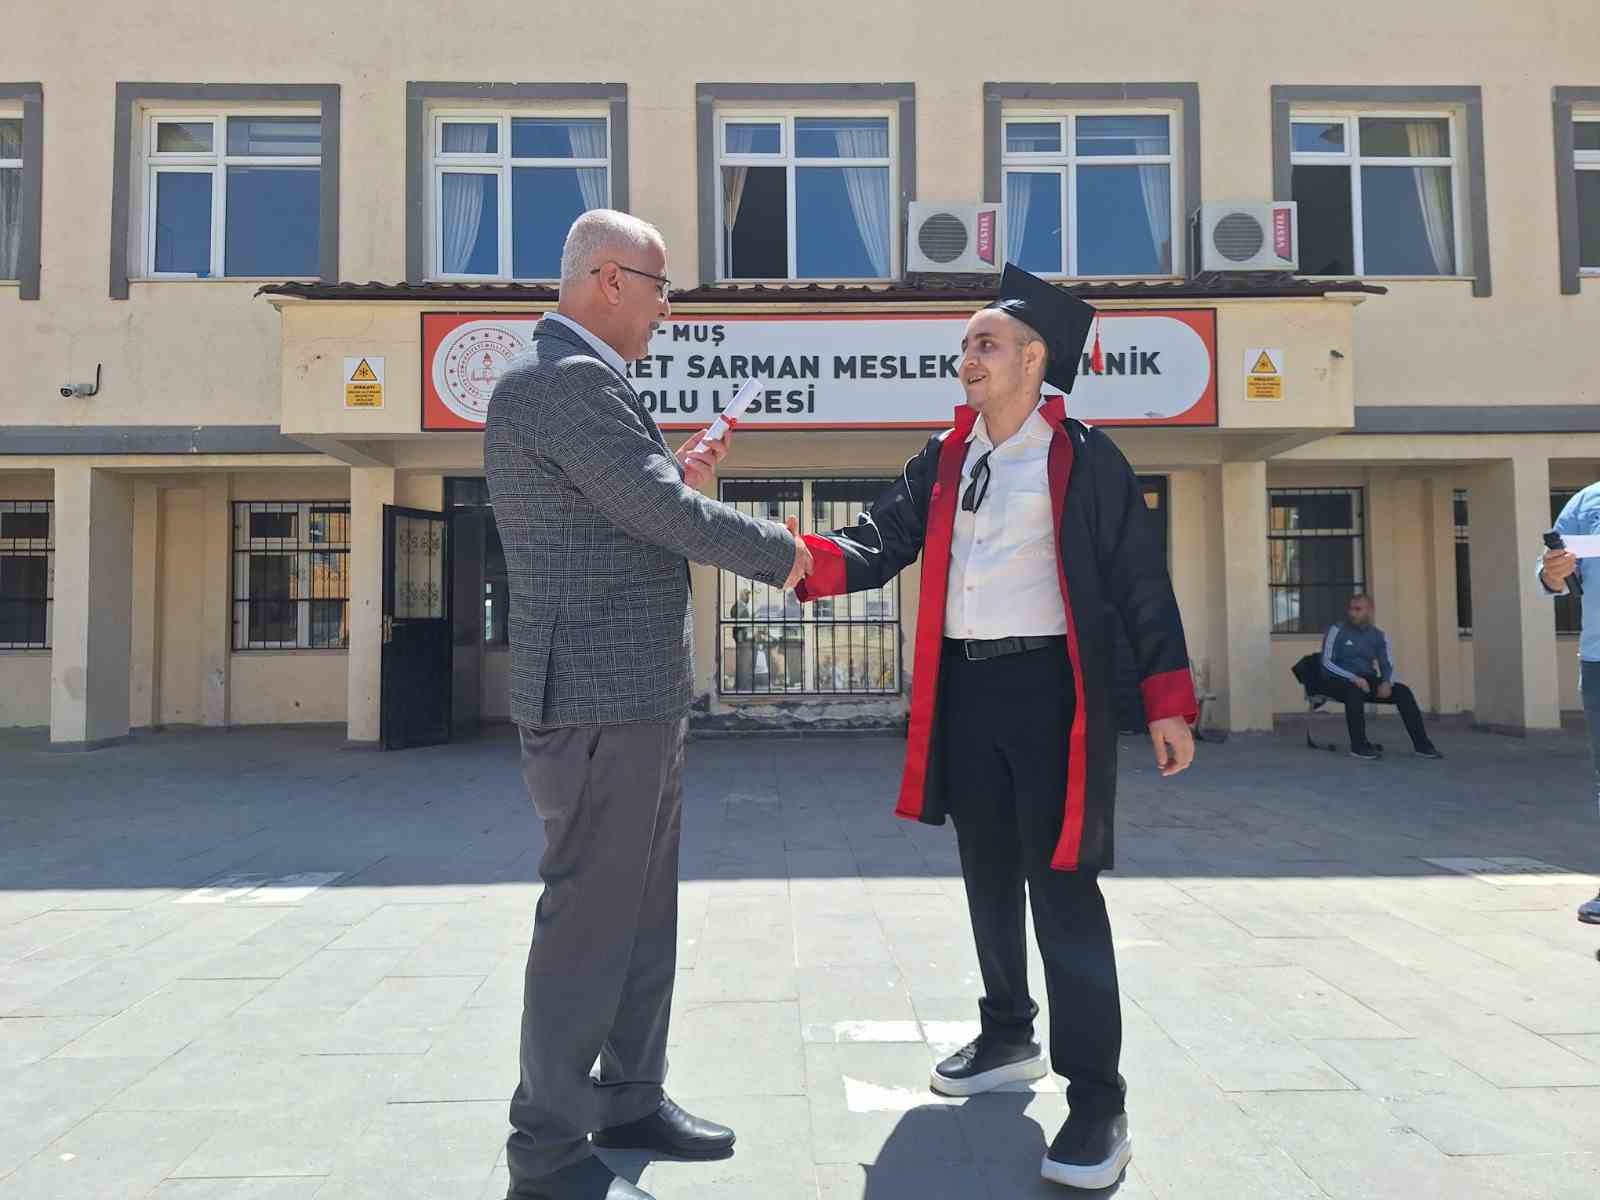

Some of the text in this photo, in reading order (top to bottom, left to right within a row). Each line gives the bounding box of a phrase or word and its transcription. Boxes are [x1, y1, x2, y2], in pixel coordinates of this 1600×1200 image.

[980, 216, 989, 251] VESTEL
[1276, 214, 1285, 248] VESTEL
[687, 355, 819, 379] SARMAN
[834, 355, 960, 379] MESLEK
